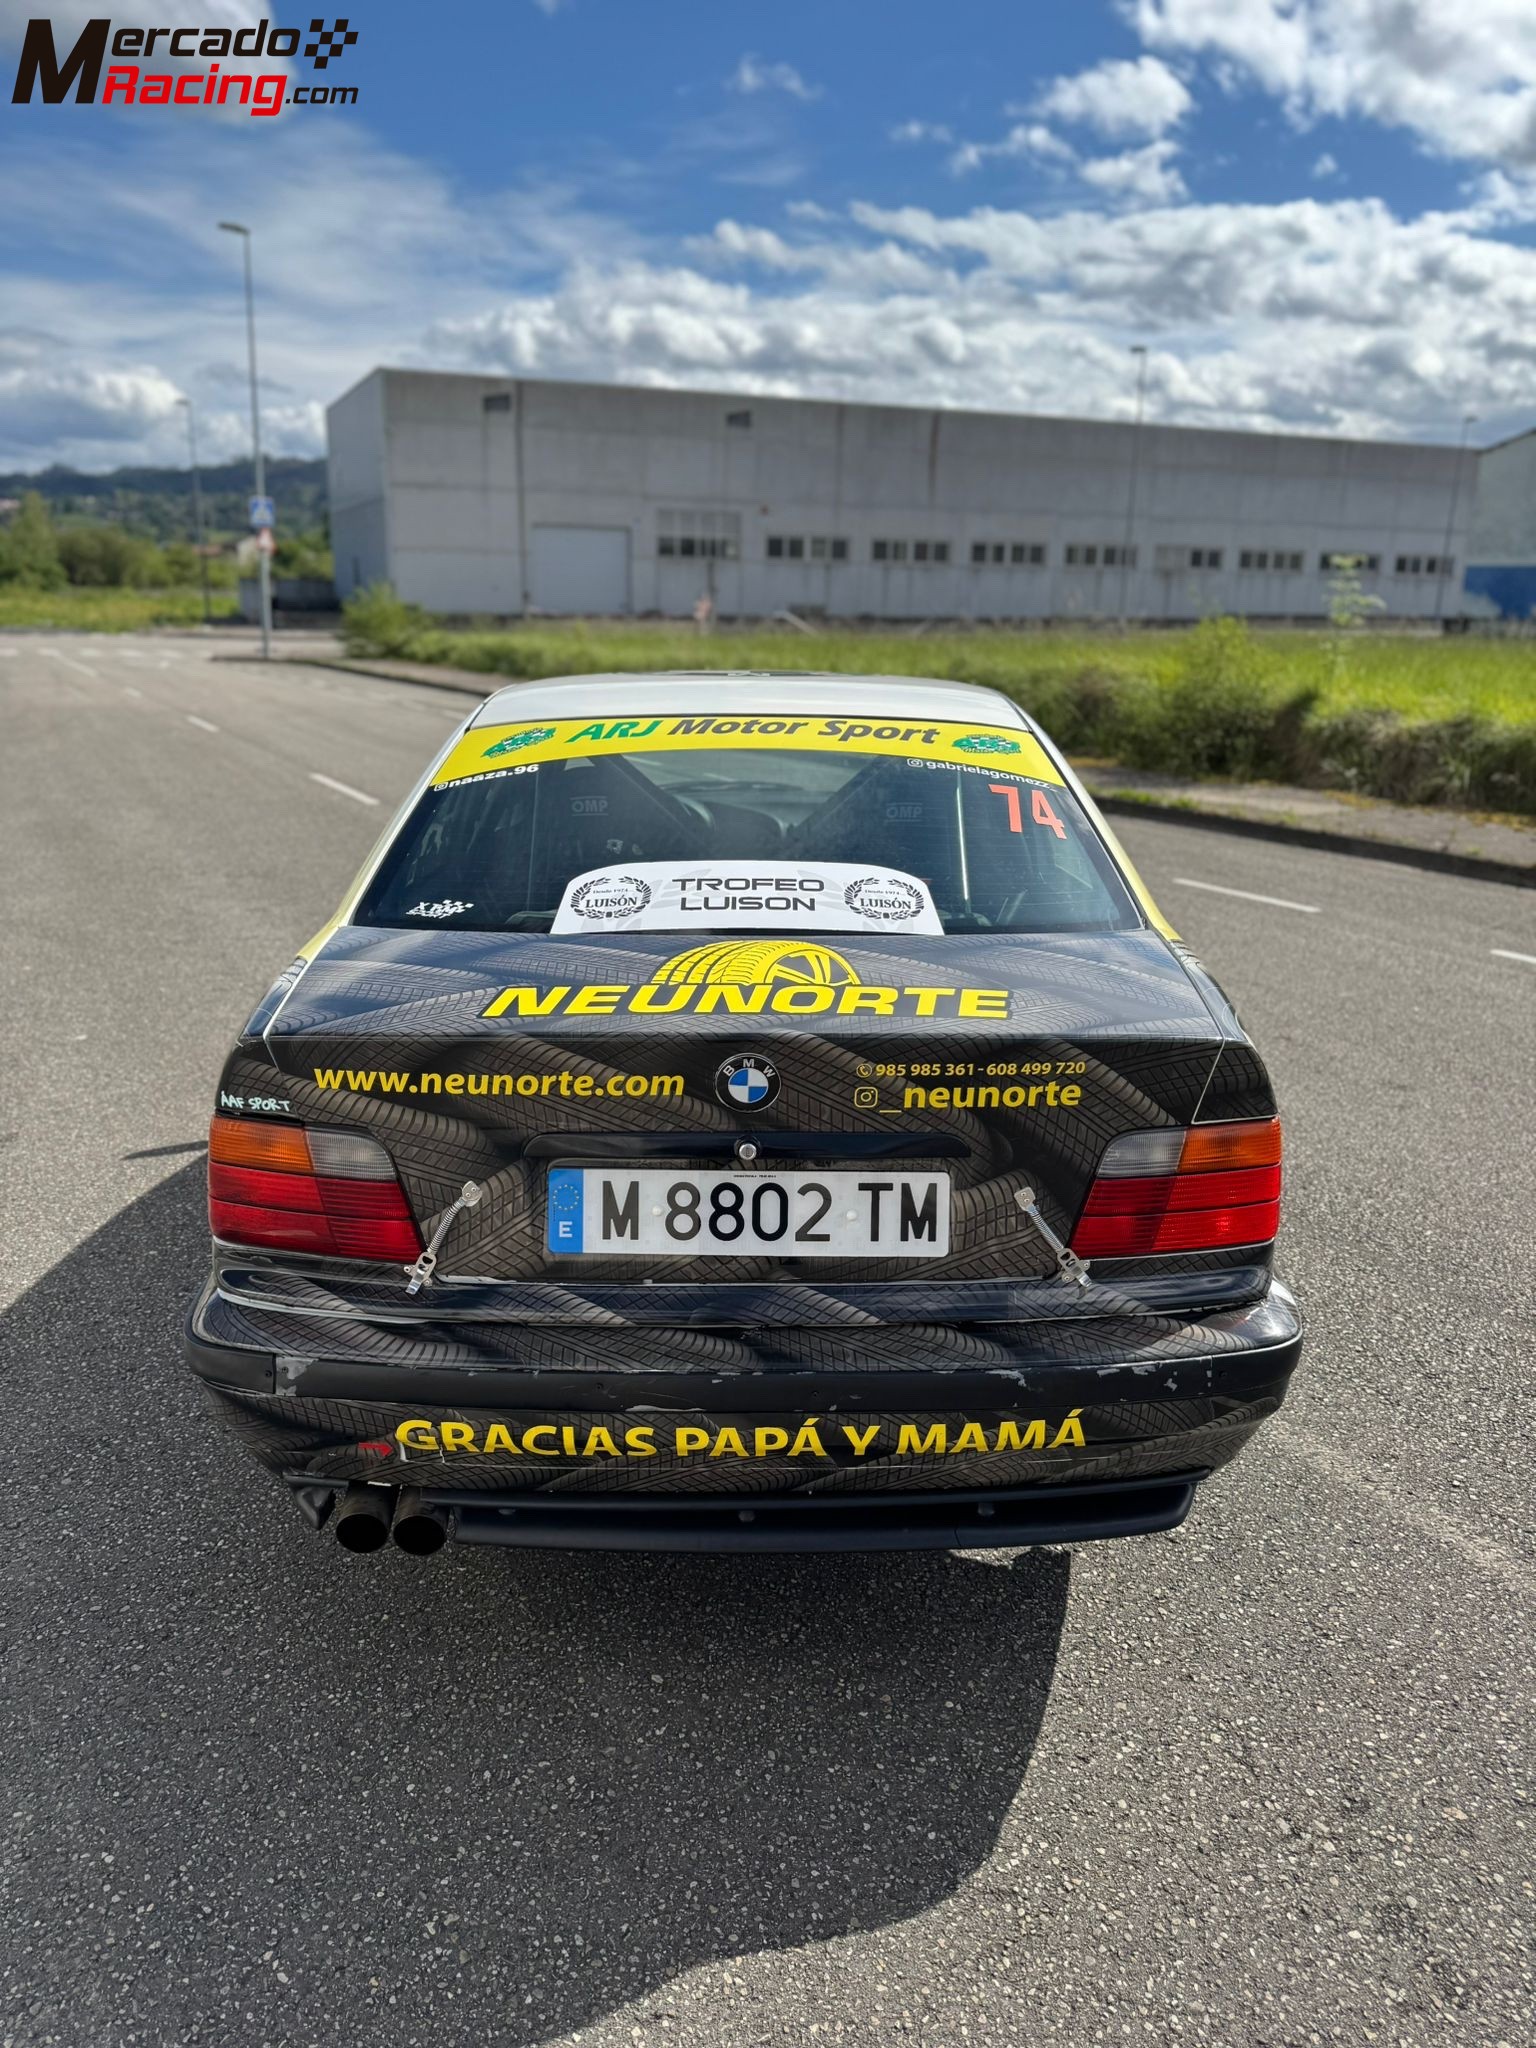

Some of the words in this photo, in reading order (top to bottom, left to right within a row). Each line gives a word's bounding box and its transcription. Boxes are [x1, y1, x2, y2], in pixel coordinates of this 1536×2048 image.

[564, 719, 665, 744] ARJ
[667, 718, 809, 736] Motor
[817, 720, 941, 744] Sport
[448, 763, 540, 789] naaza.96
[571, 800, 608, 813] OMP
[886, 805, 923, 819] OMP
[988, 783, 1067, 840] 74
[672, 878, 825, 892] TROFEO
[585, 894, 638, 909] LUISÓN
[680, 896, 816, 912] LUISON
[860, 897, 912, 910] LUISÓN
[482, 985, 1011, 1019] NEUNORTE
[723, 1058, 776, 1077] BMW
[875, 1063, 907, 1077] 985
[910, 1063, 942, 1077] 985
[1020, 1062, 1052, 1075] 499
[1055, 1061, 1086, 1075] 720
[314, 1068, 685, 1097] www.neunorte.com
[248, 1097, 290, 1112] SPORT
[602, 1180, 639, 1241] M
[665, 1181, 832, 1242] 8802
[858, 1182, 938, 1242] TM
[558, 1221, 573, 1238] E
[395, 1420, 656, 1457] GRACIAS
[675, 1417, 828, 1457] PAPÁ
[841, 1425, 881, 1455] Y
[896, 1408, 1087, 1455] MAMÁ
